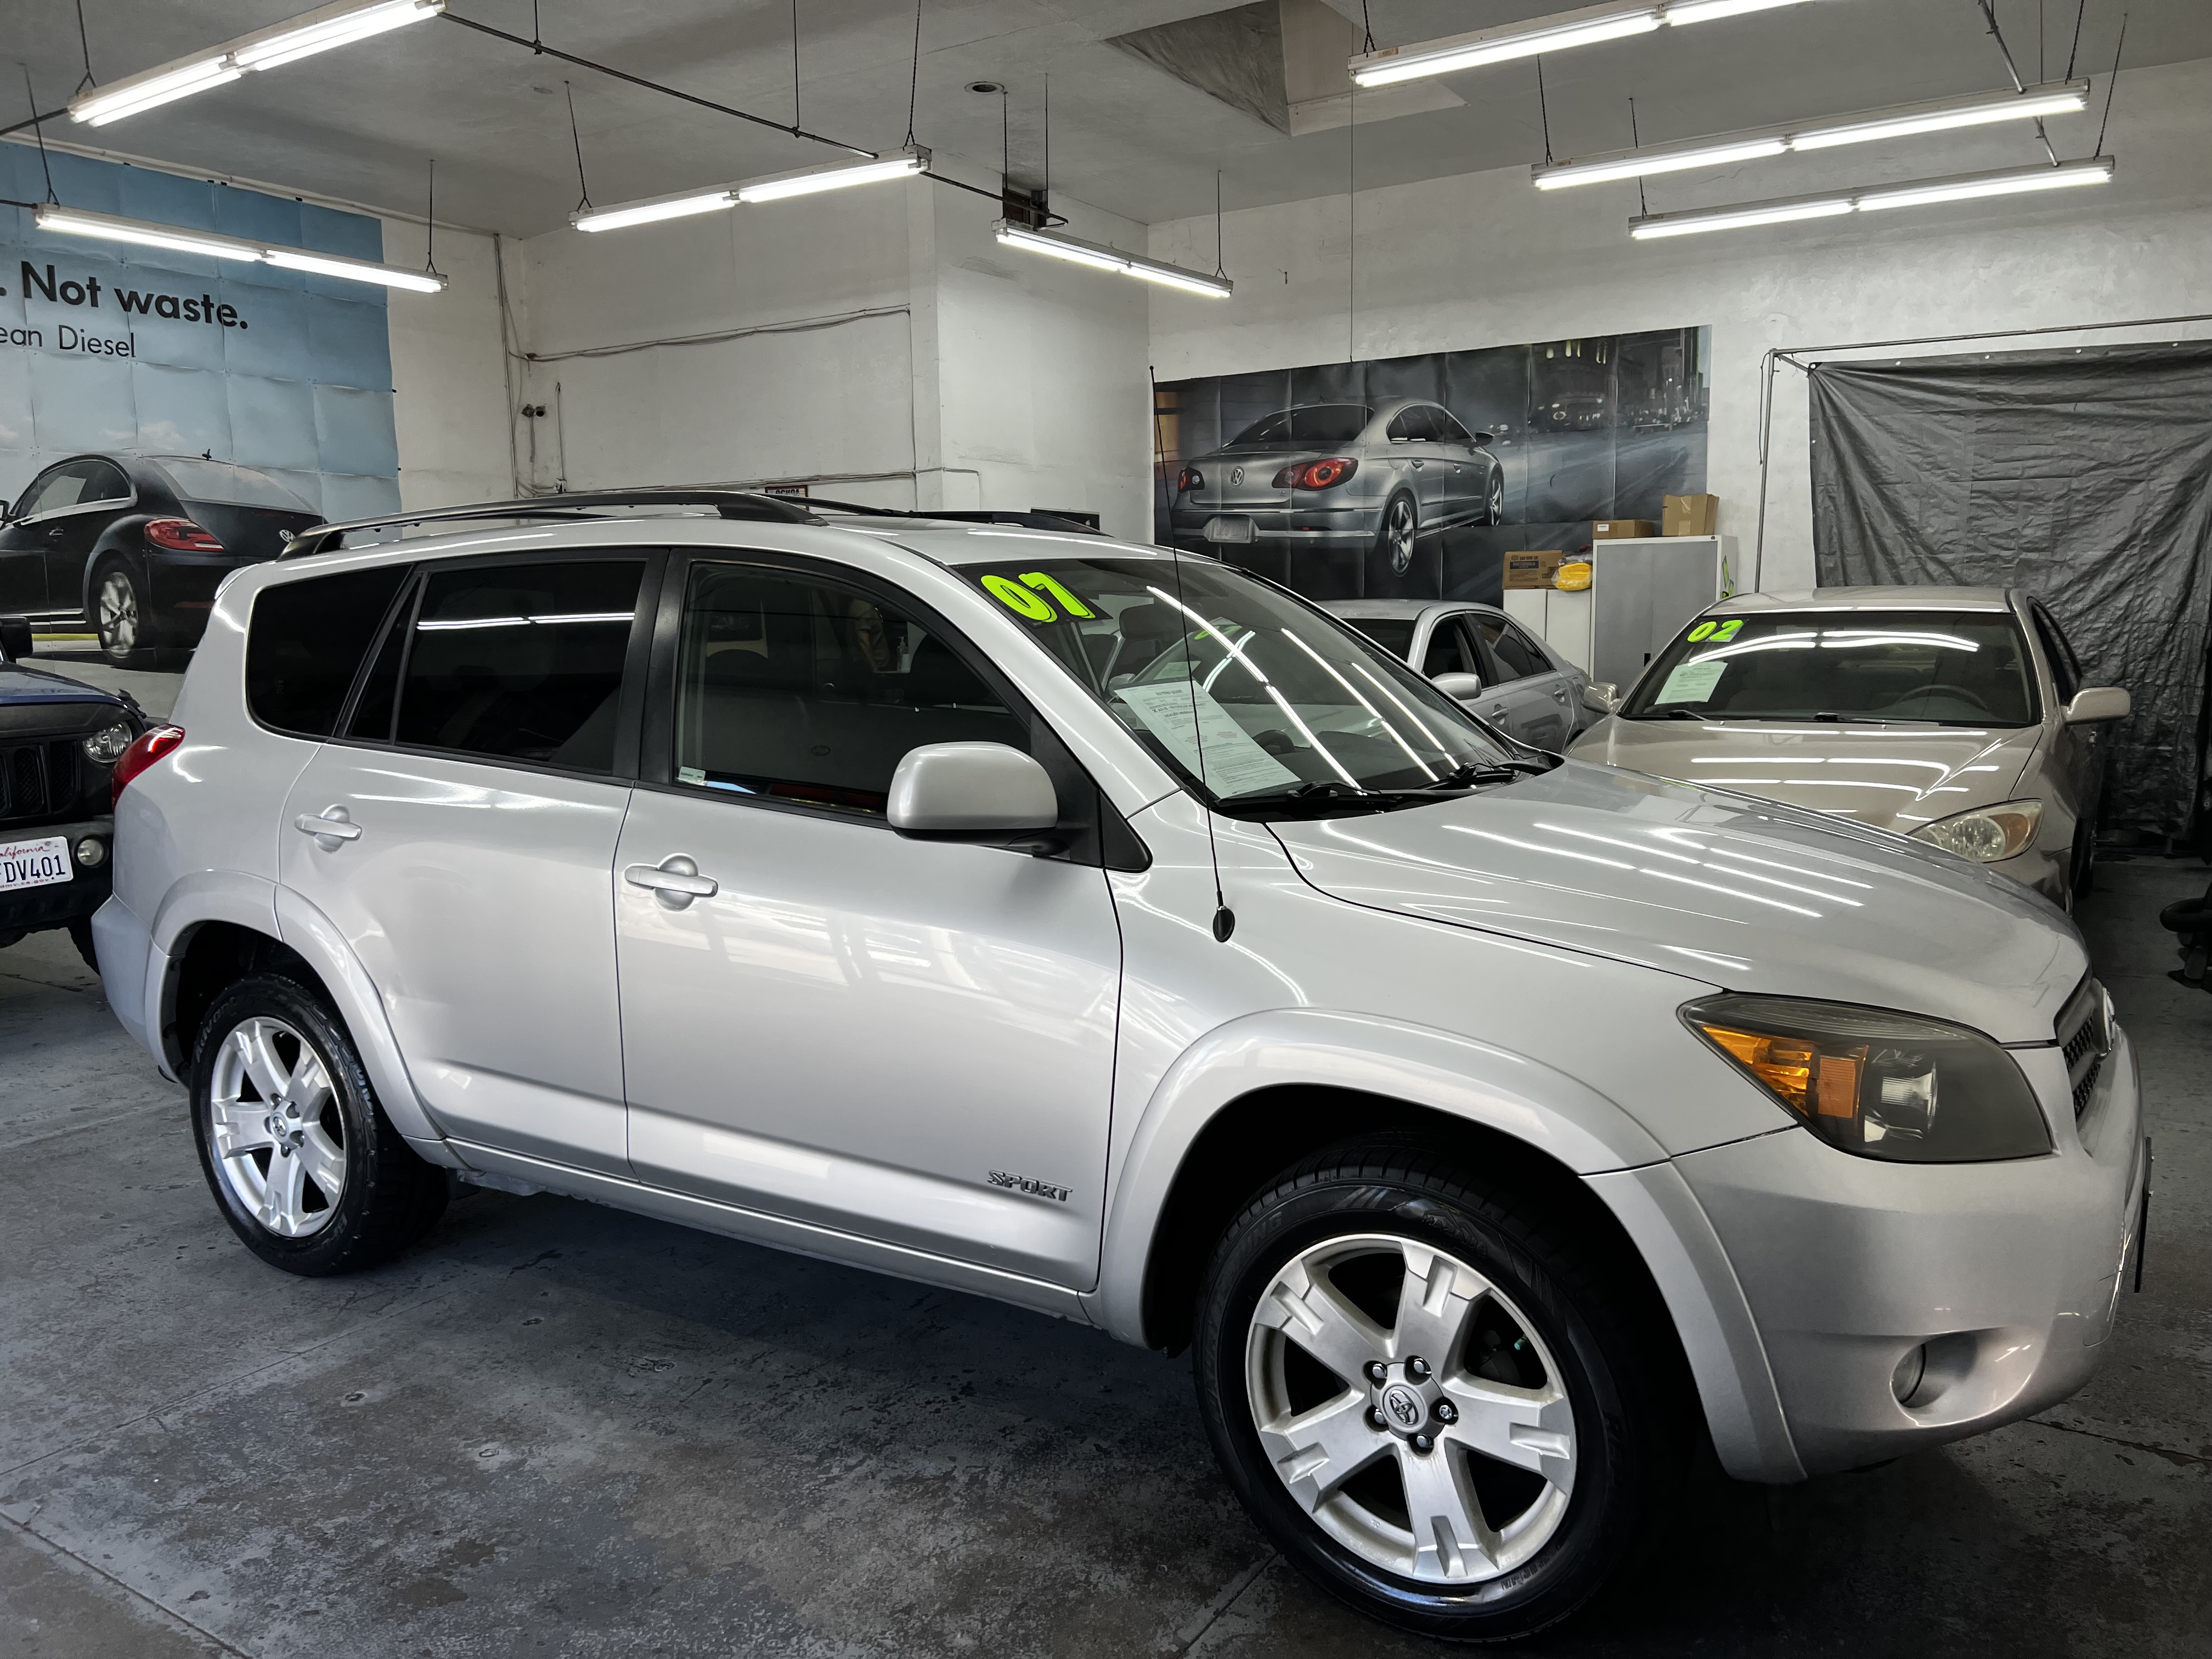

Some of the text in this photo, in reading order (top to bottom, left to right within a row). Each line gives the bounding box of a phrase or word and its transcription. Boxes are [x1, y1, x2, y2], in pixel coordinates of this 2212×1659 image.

[21, 261, 101, 307] Not
[114, 287, 248, 329] waste.
[59, 325, 136, 358] Diesel
[981, 572, 1096, 622] 07
[1688, 619, 1743, 642] 02
[0, 855, 65, 883] DV401
[988, 1170, 1073, 1201] SPORT
